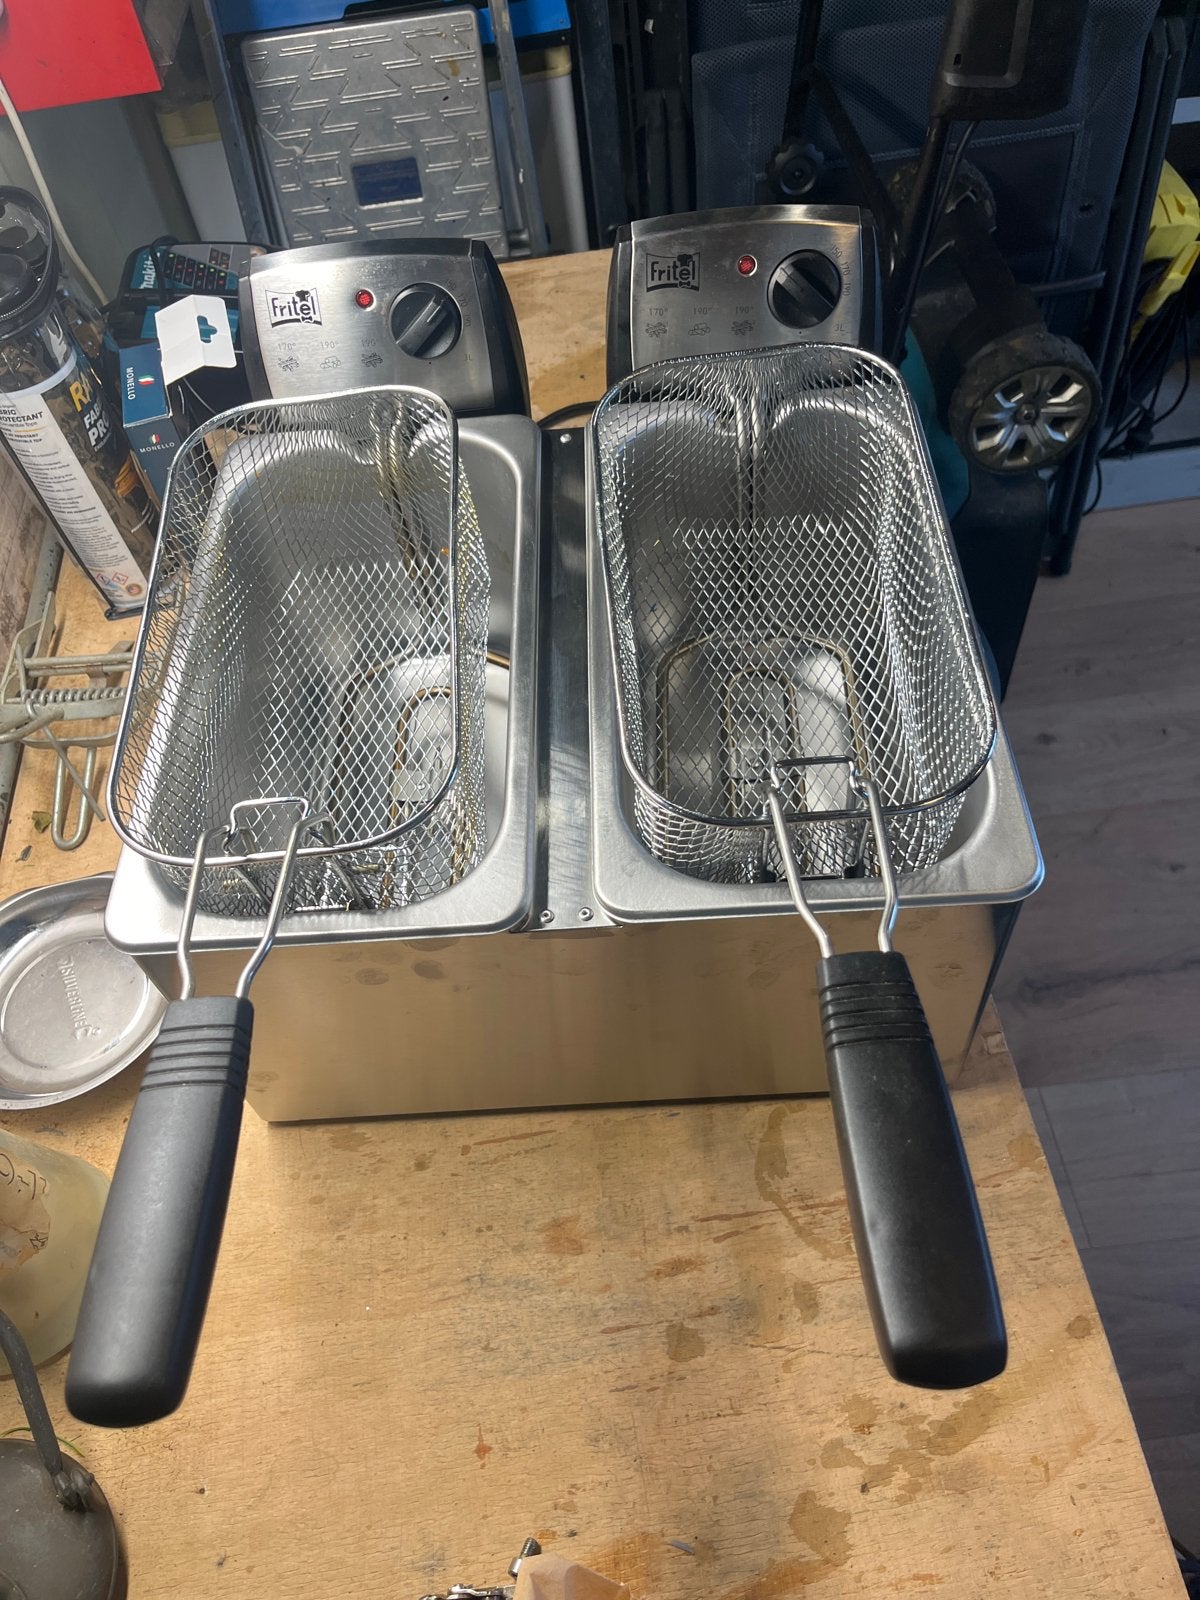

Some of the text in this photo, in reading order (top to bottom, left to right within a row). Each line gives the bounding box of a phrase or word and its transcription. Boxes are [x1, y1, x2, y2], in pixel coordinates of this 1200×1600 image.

[841, 261, 851, 276] 170
[126, 367, 135, 400] MONELLO
[139, 442, 175, 453] MONELLO
